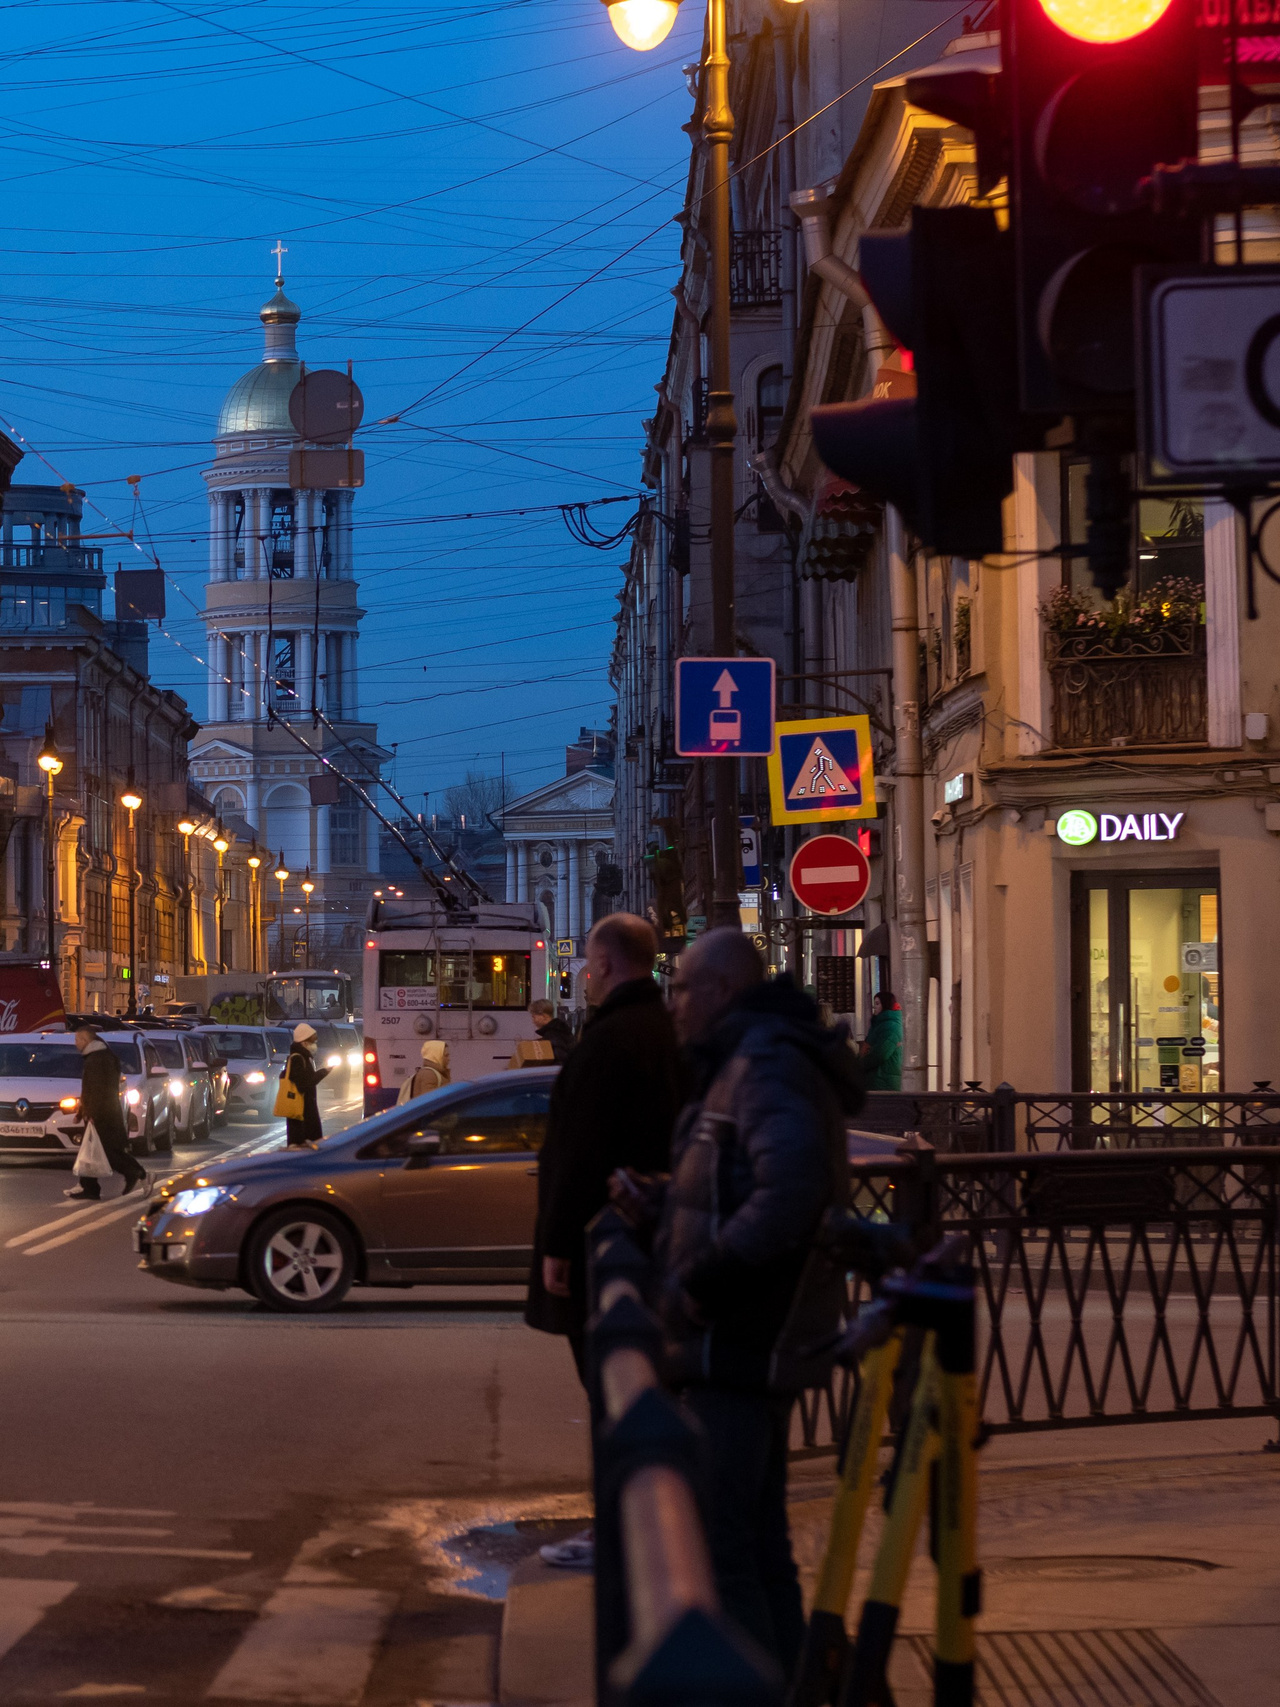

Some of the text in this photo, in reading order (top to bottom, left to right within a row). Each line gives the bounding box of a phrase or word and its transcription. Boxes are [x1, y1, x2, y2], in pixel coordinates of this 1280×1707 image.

[1100, 812, 1185, 842] DAILY
[1093, 948, 1109, 960] DAI
[493, 957, 503, 972] 3
[381, 1017, 401, 1025] 2507
